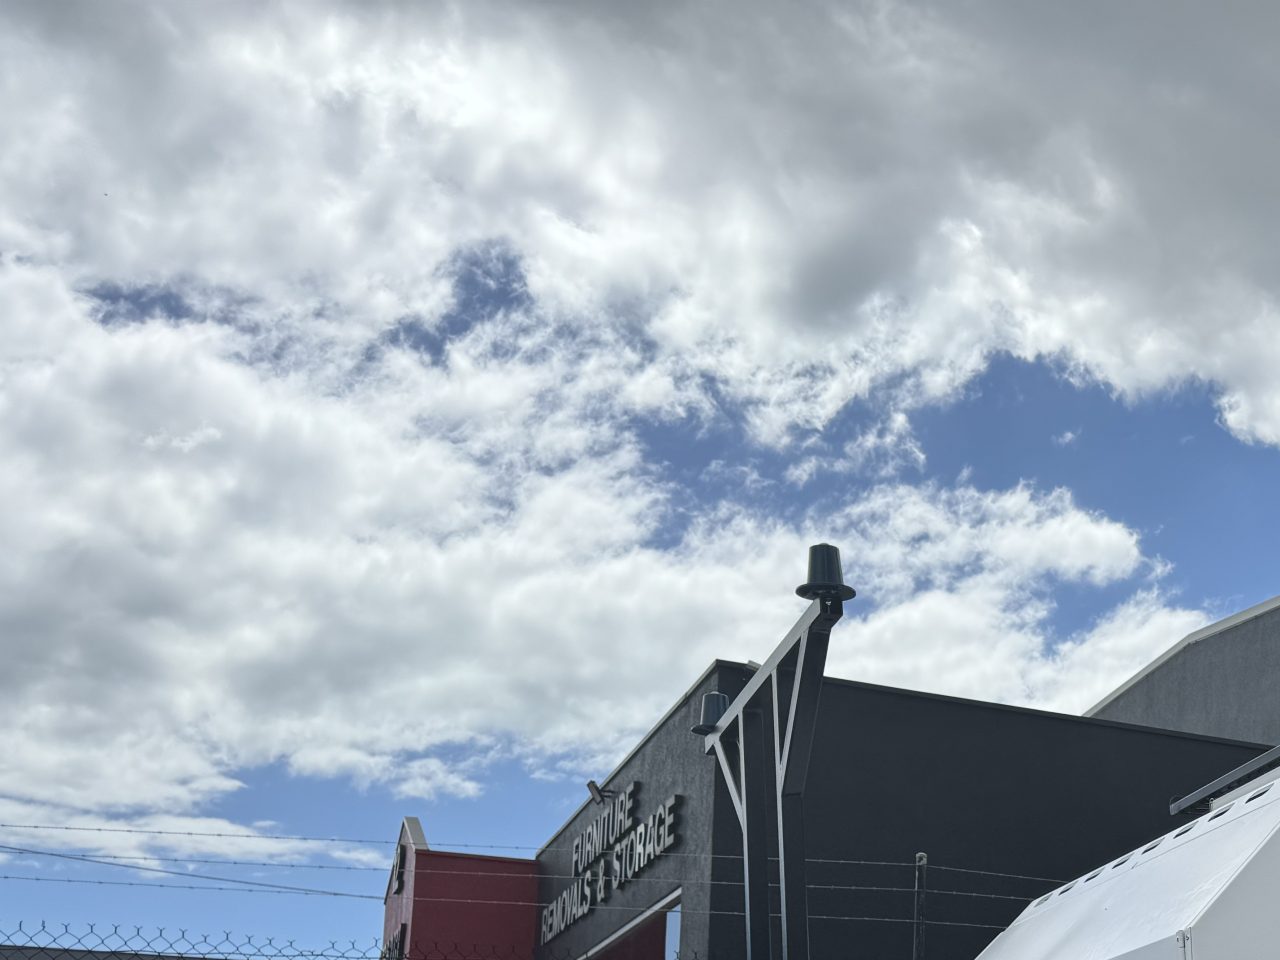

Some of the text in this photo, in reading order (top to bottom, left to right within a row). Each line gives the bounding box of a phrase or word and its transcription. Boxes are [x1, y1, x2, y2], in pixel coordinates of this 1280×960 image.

[540, 795, 677, 946] REMOVALS & STORAGE
[572, 781, 637, 878] FURNITURE
